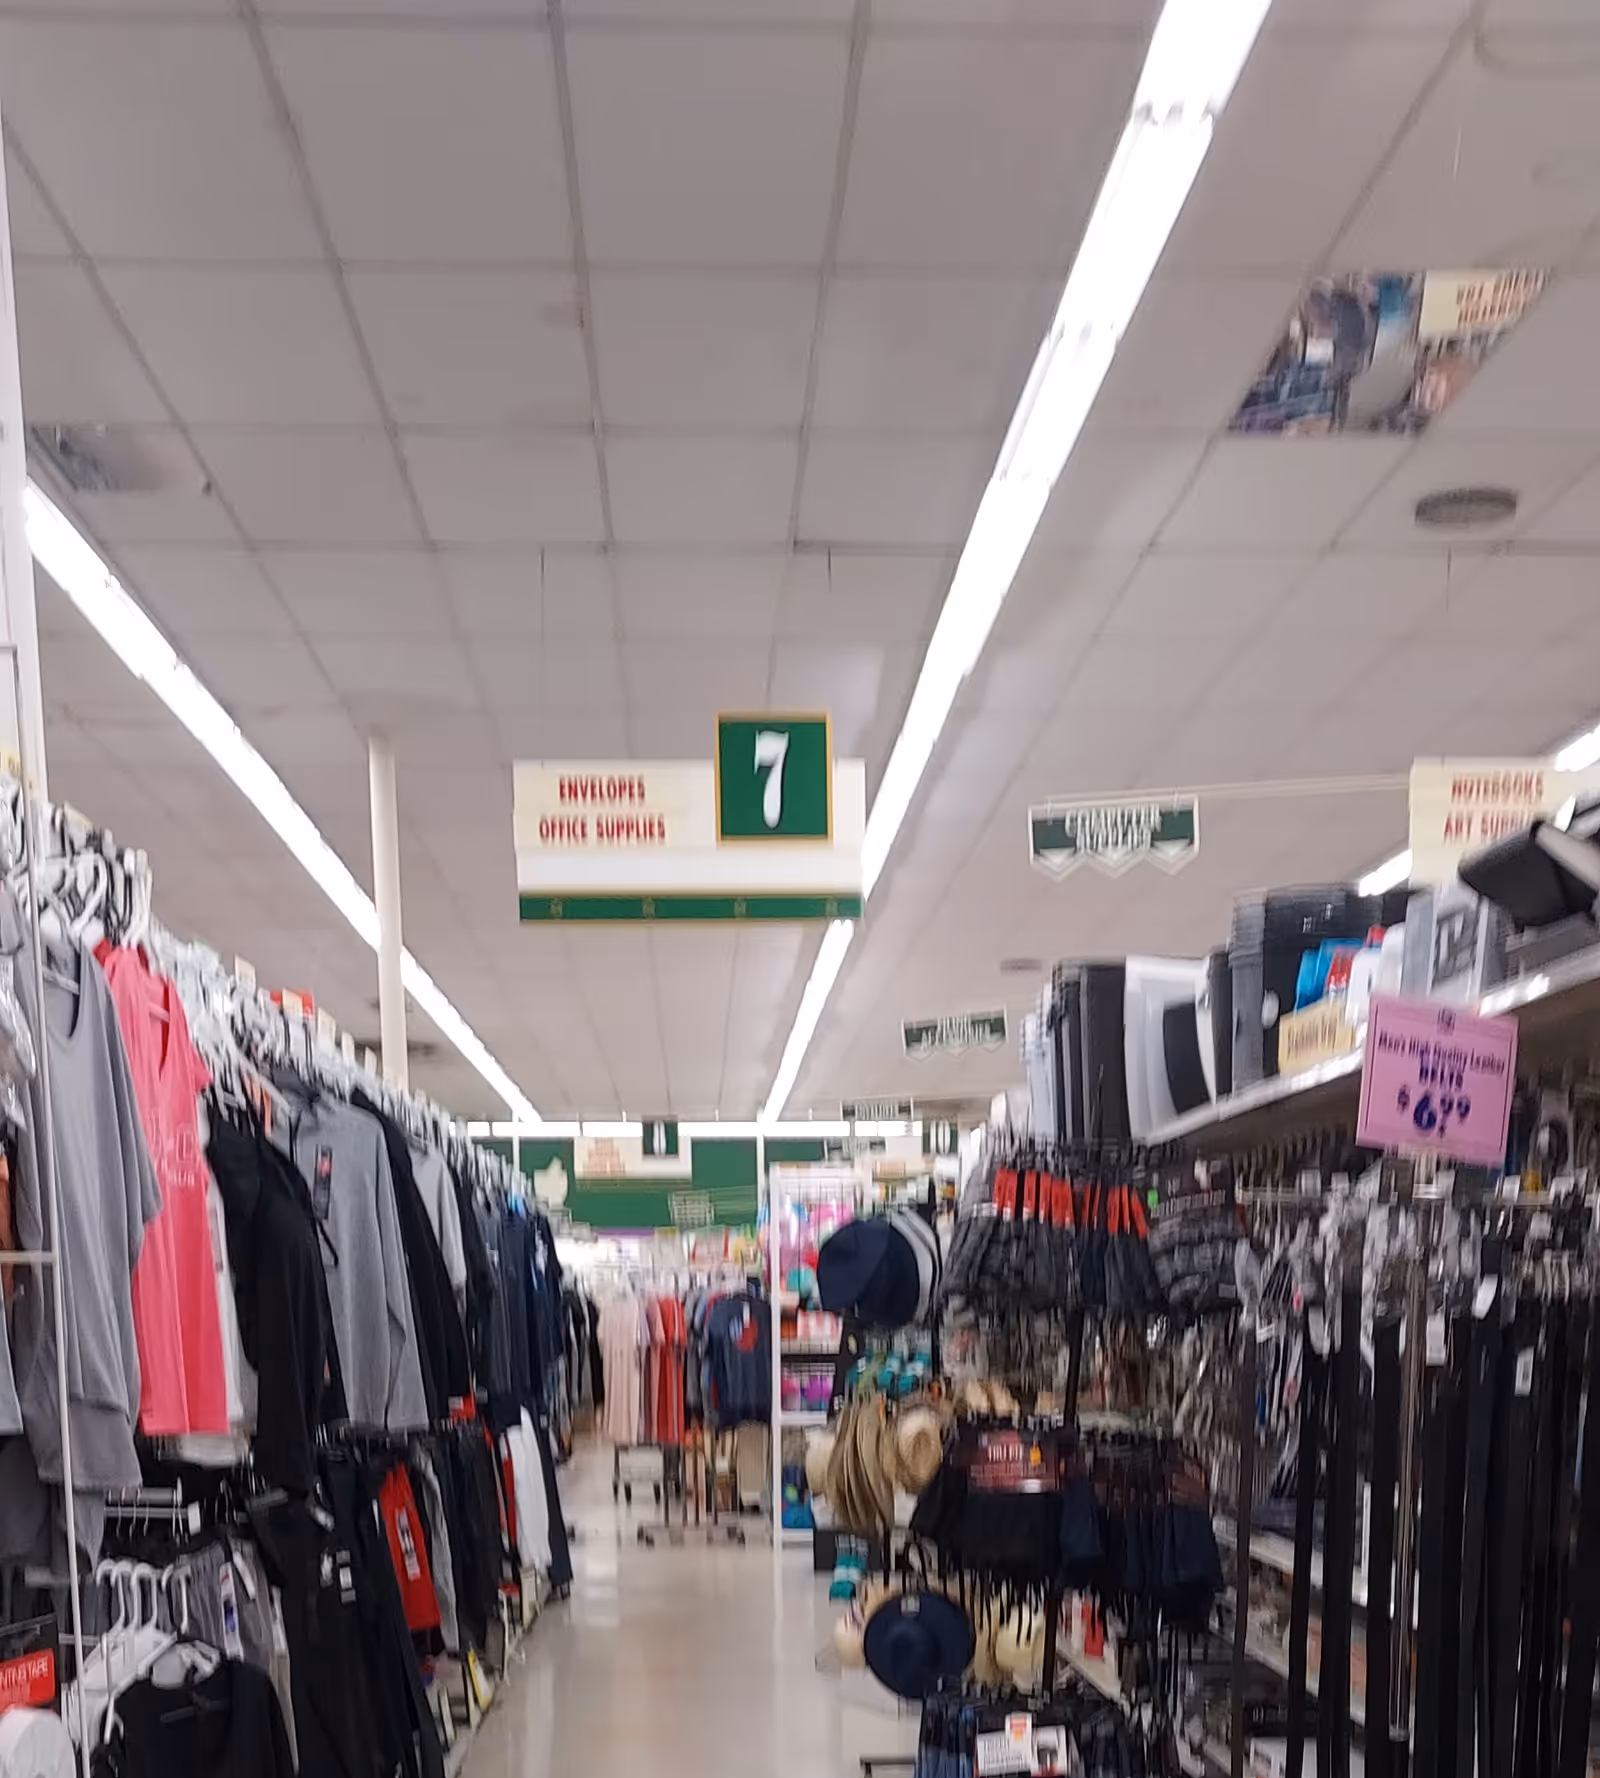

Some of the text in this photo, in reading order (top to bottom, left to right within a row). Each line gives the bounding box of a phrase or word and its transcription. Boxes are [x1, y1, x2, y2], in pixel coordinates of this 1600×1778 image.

[559, 775, 645, 803] ENVELOPES
[754, 729, 790, 829] 7
[1451, 773, 1544, 800] NOTEBOOKS
[539, 815, 665, 842] OFFICE SUPPLIES
[1444, 811, 1472, 839] ART
[1378, 1031, 1505, 1076] Men's High Quality Leather
